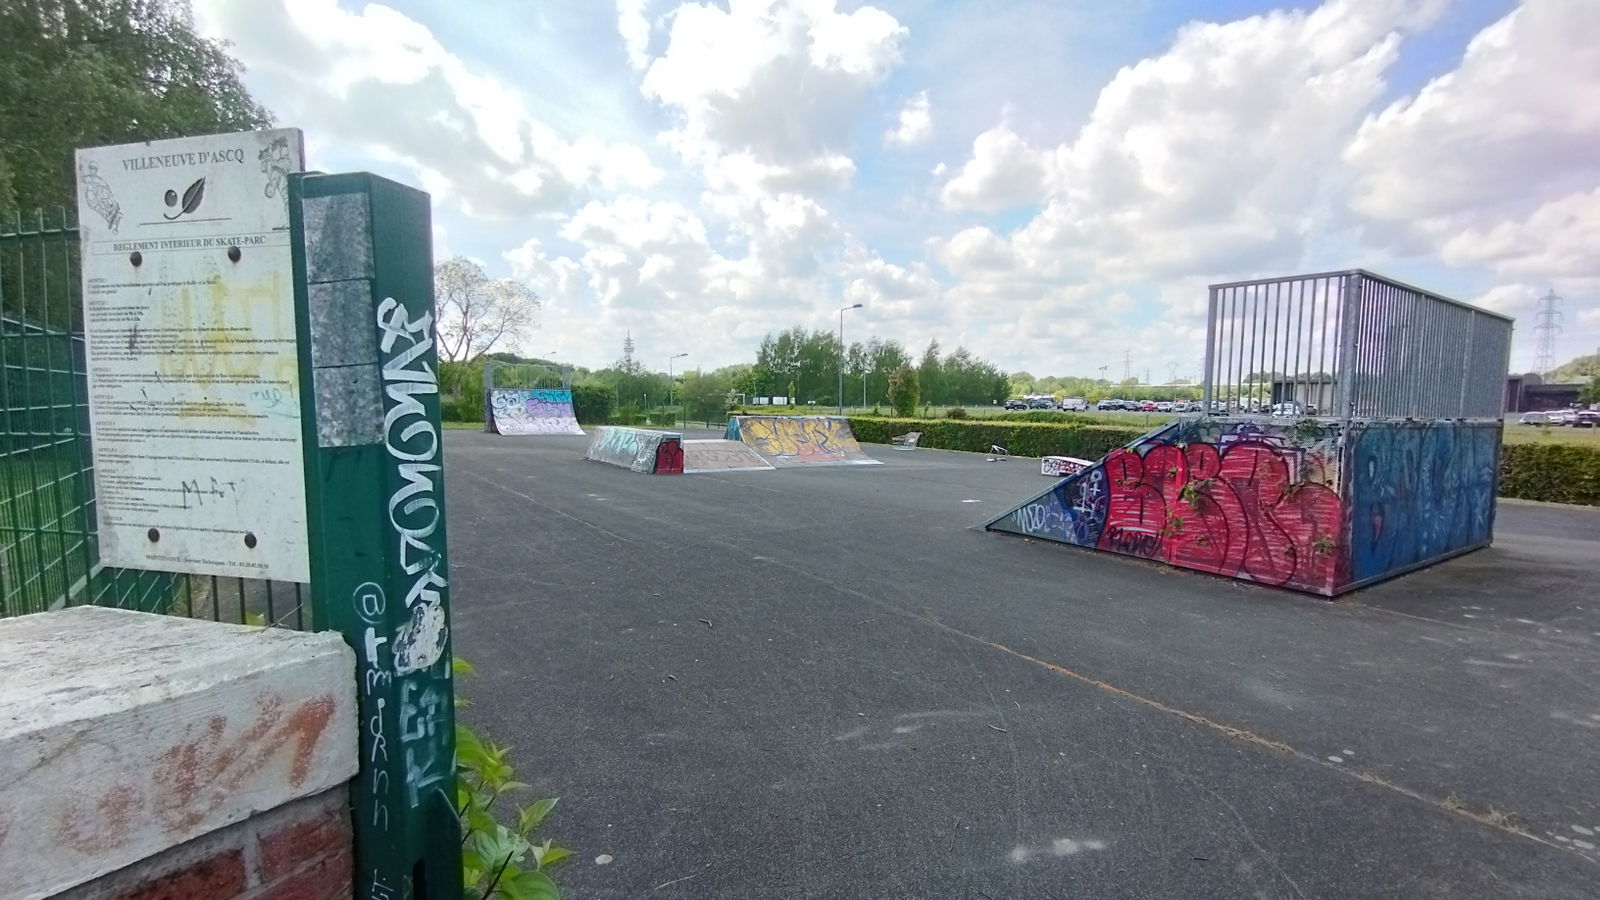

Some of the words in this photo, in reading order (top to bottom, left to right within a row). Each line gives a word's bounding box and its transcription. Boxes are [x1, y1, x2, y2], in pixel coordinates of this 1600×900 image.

[122, 152, 196, 171] VILLENEUVE
[199, 148, 245, 164] D'ASCQ
[203, 238, 215, 247] DU
[216, 235, 266, 246] SKATE-PARC
